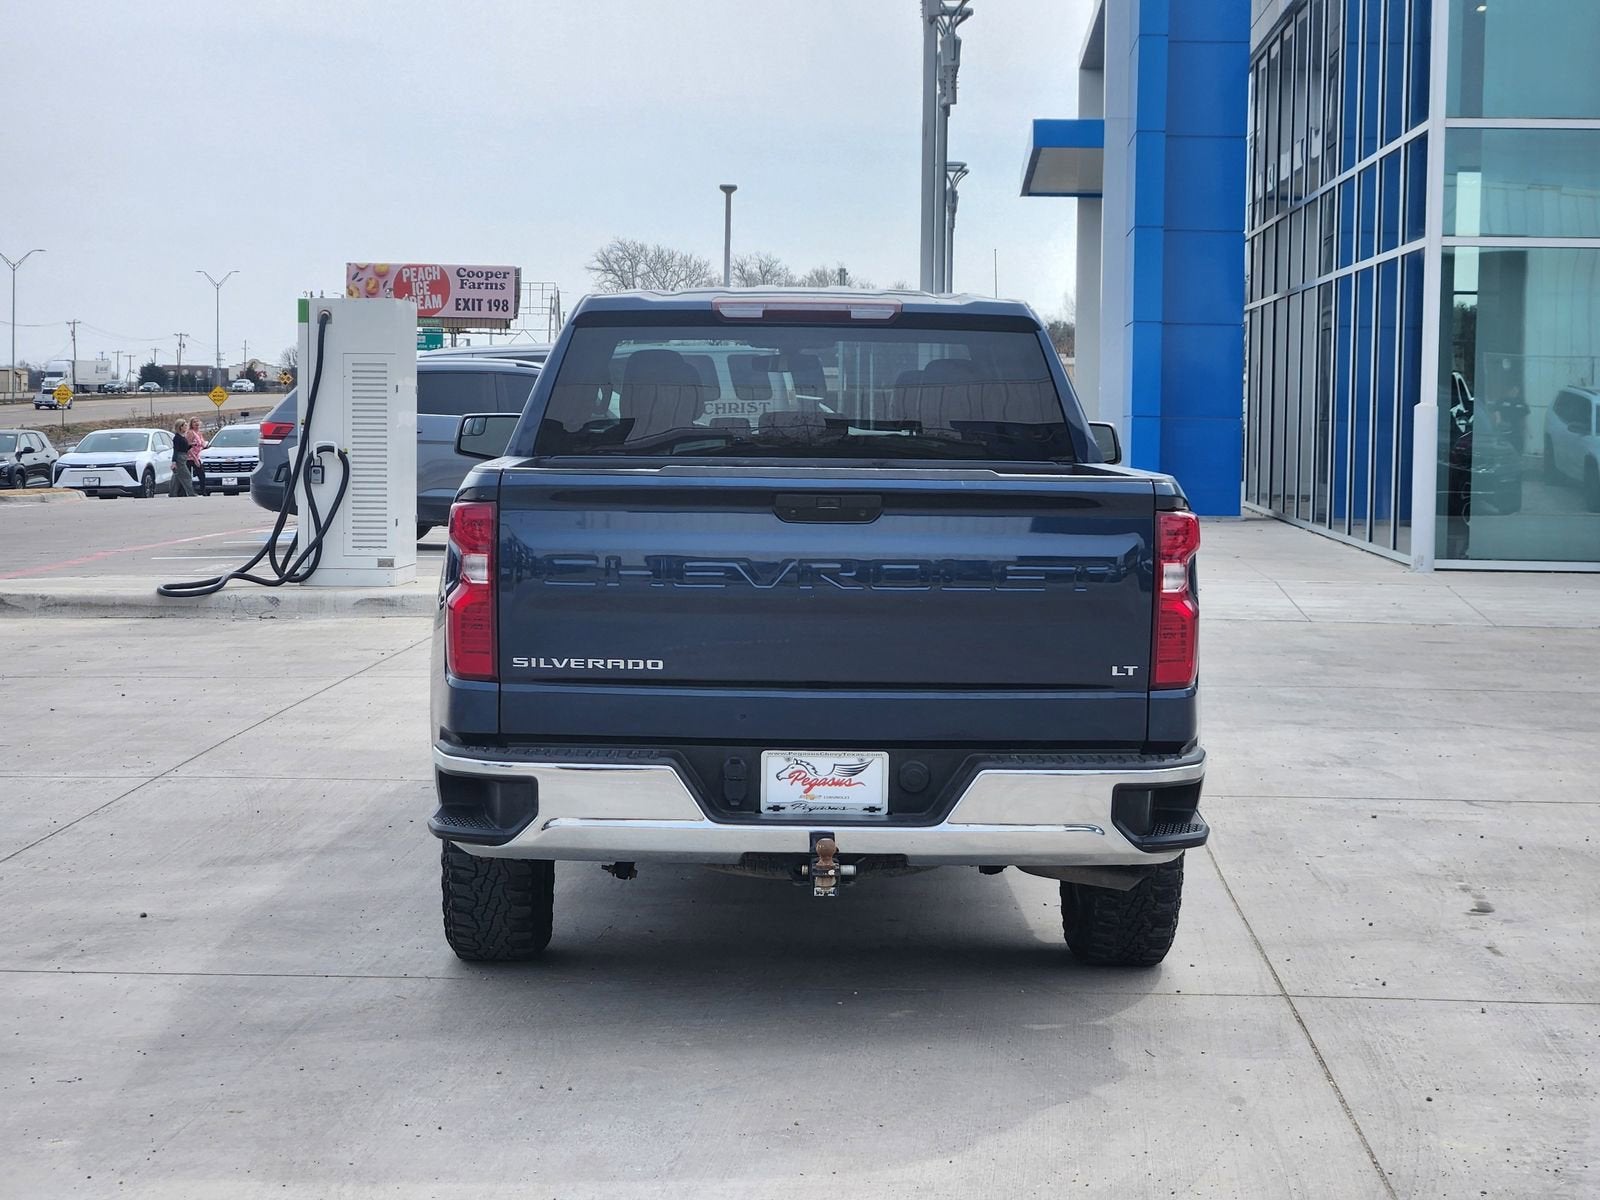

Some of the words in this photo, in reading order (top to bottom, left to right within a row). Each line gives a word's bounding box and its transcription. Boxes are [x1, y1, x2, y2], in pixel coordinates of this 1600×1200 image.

[402, 266, 441, 283] PEACH
[456, 267, 510, 281] Cooper
[411, 281, 431, 296] ICE
[459, 278, 506, 291] Farms
[455, 297, 484, 312] EXIT
[486, 298, 510, 313] 198
[703, 401, 771, 415] CHRIST
[511, 656, 664, 671] SILVERADO
[1111, 665, 1139, 676] LT
[788, 769, 866, 794] Pegasus
